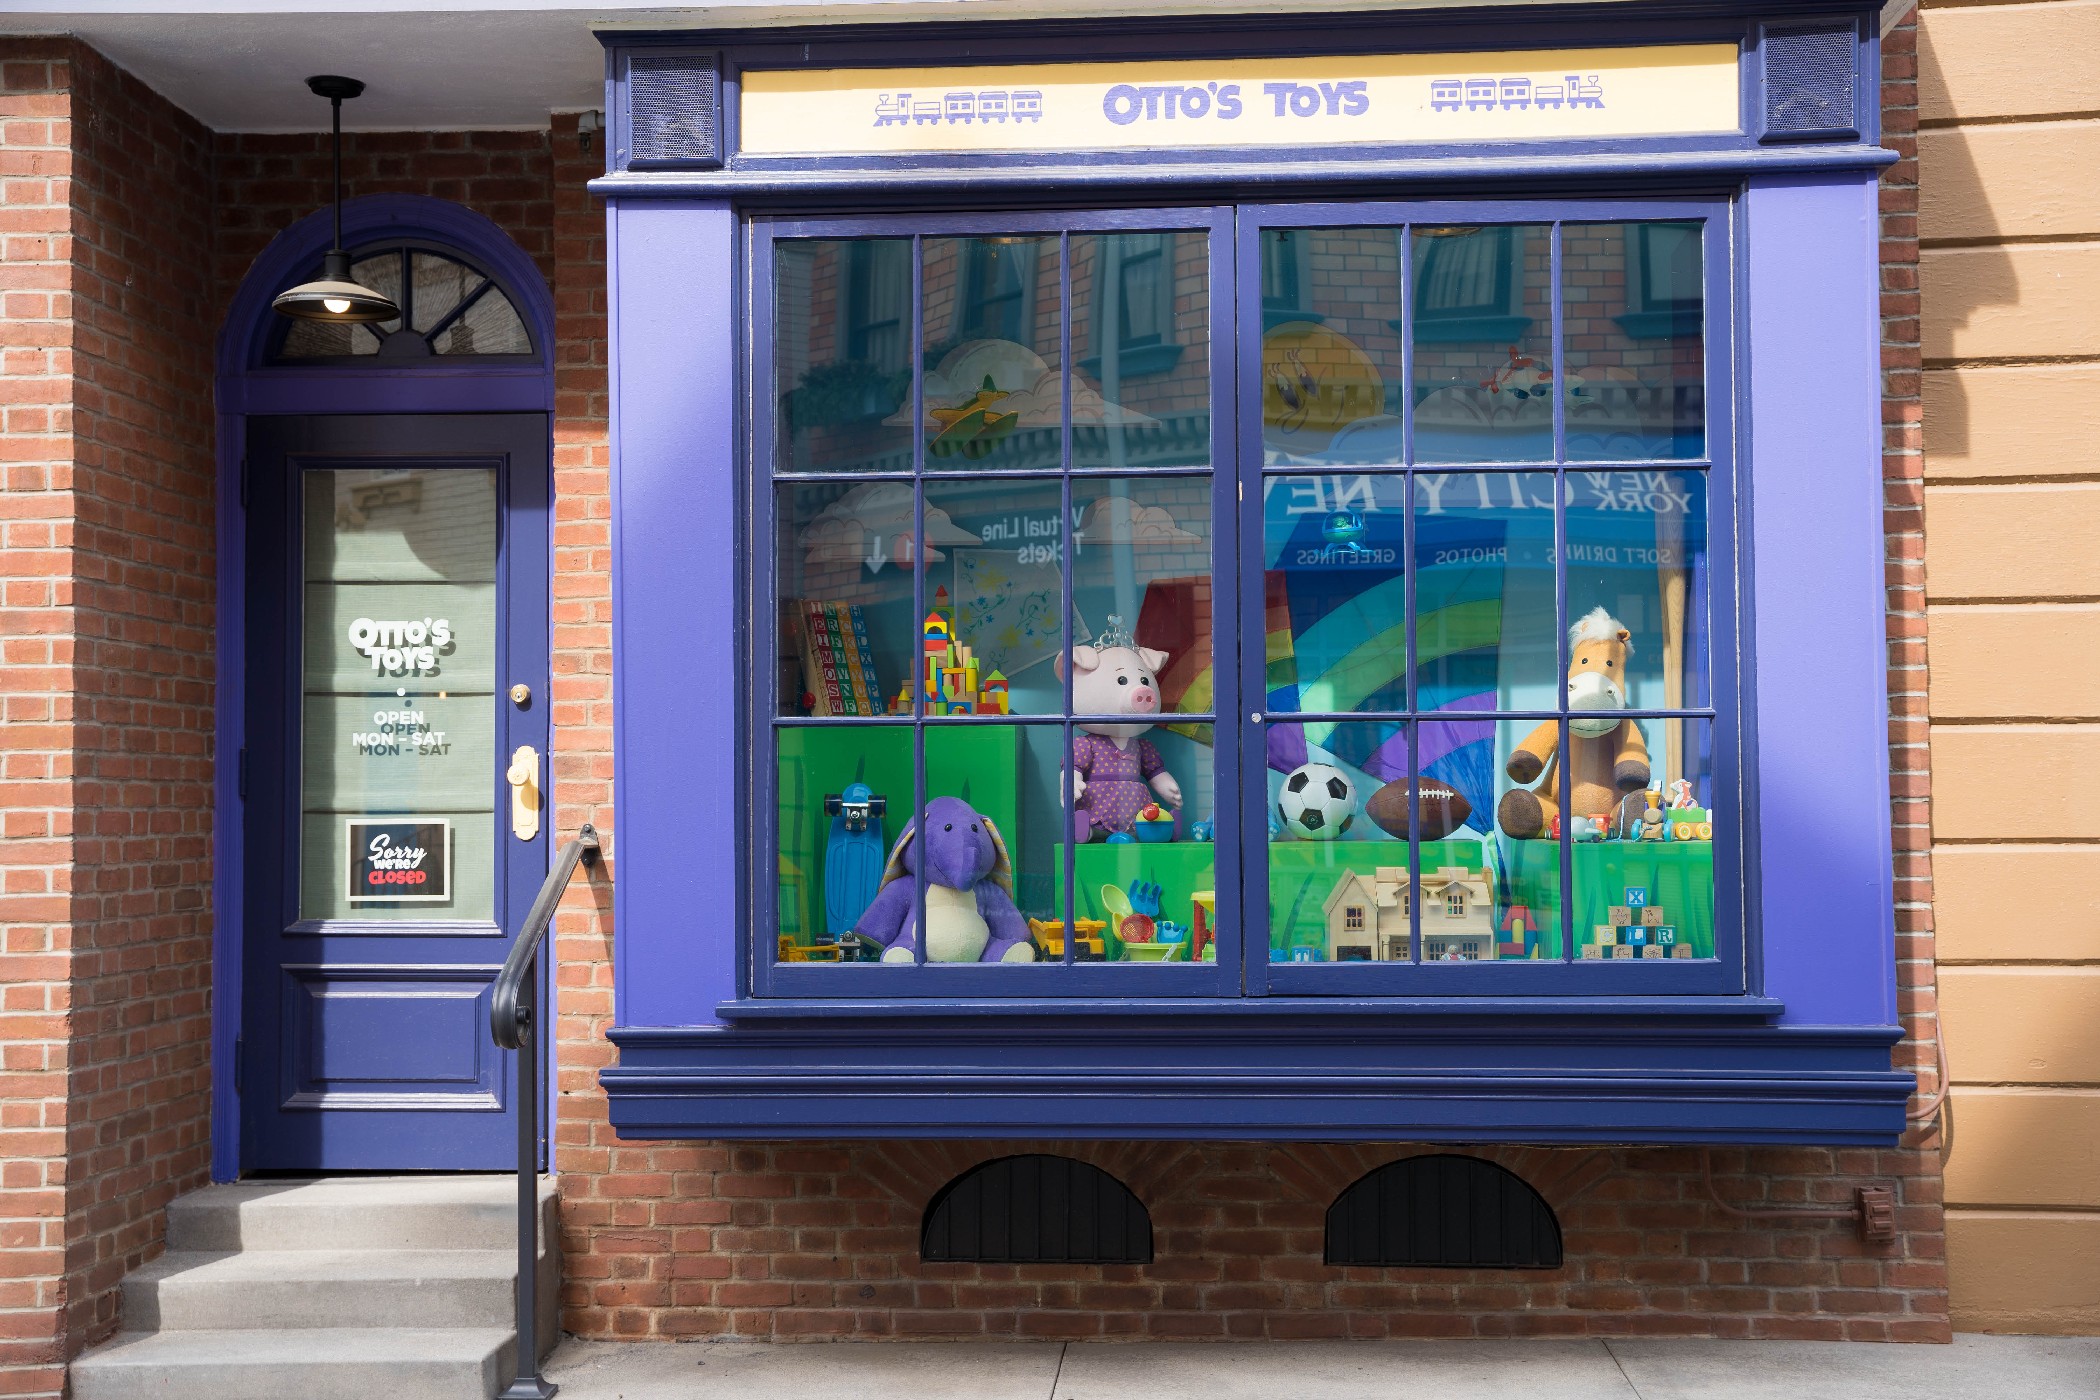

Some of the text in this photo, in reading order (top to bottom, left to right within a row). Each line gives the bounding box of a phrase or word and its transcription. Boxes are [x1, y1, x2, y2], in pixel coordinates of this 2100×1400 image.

[1103, 81, 1370, 125] OTTO'S TOYS
[348, 617, 451, 649] OTTO'S
[365, 646, 435, 670] TOYS
[373, 711, 424, 725] OPEN
[352, 732, 394, 746] MON
[411, 731, 445, 746] SAT
[367, 833, 428, 869] Sorry
